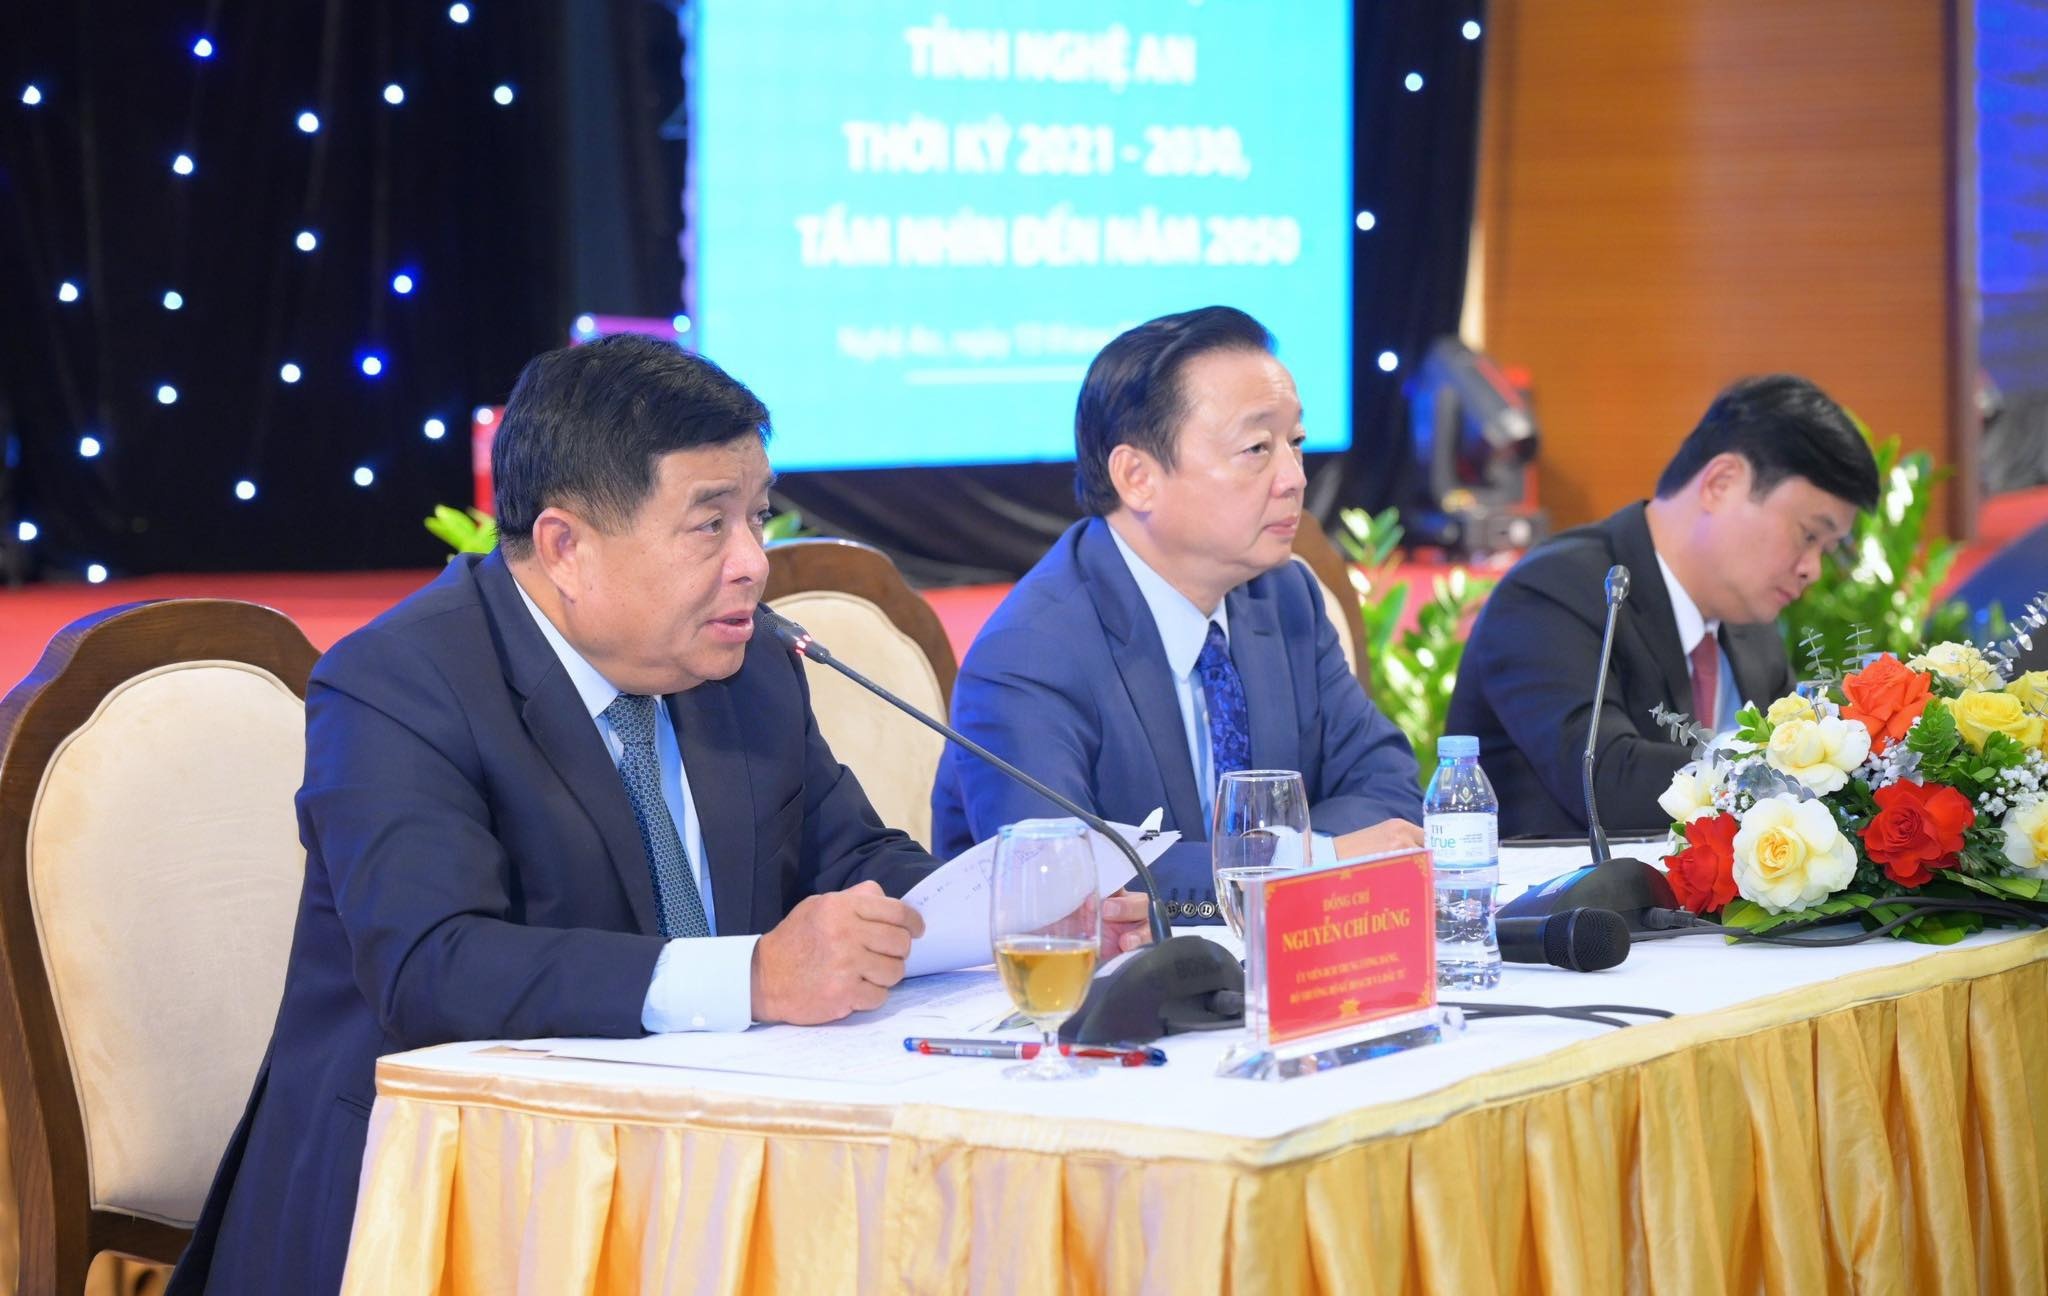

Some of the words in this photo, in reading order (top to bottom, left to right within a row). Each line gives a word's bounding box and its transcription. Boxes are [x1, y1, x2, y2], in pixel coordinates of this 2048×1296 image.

[1015, 25, 1130, 91] NGHỆ
[1134, 35, 1195, 83] AN
[1017, 123, 1115, 175] 2021
[1010, 202, 1101, 267] ĐẾN
[1204, 217, 1301, 266] 2050
[1430, 835, 1457, 848] true
[1344, 912, 1368, 939] CHÍ
